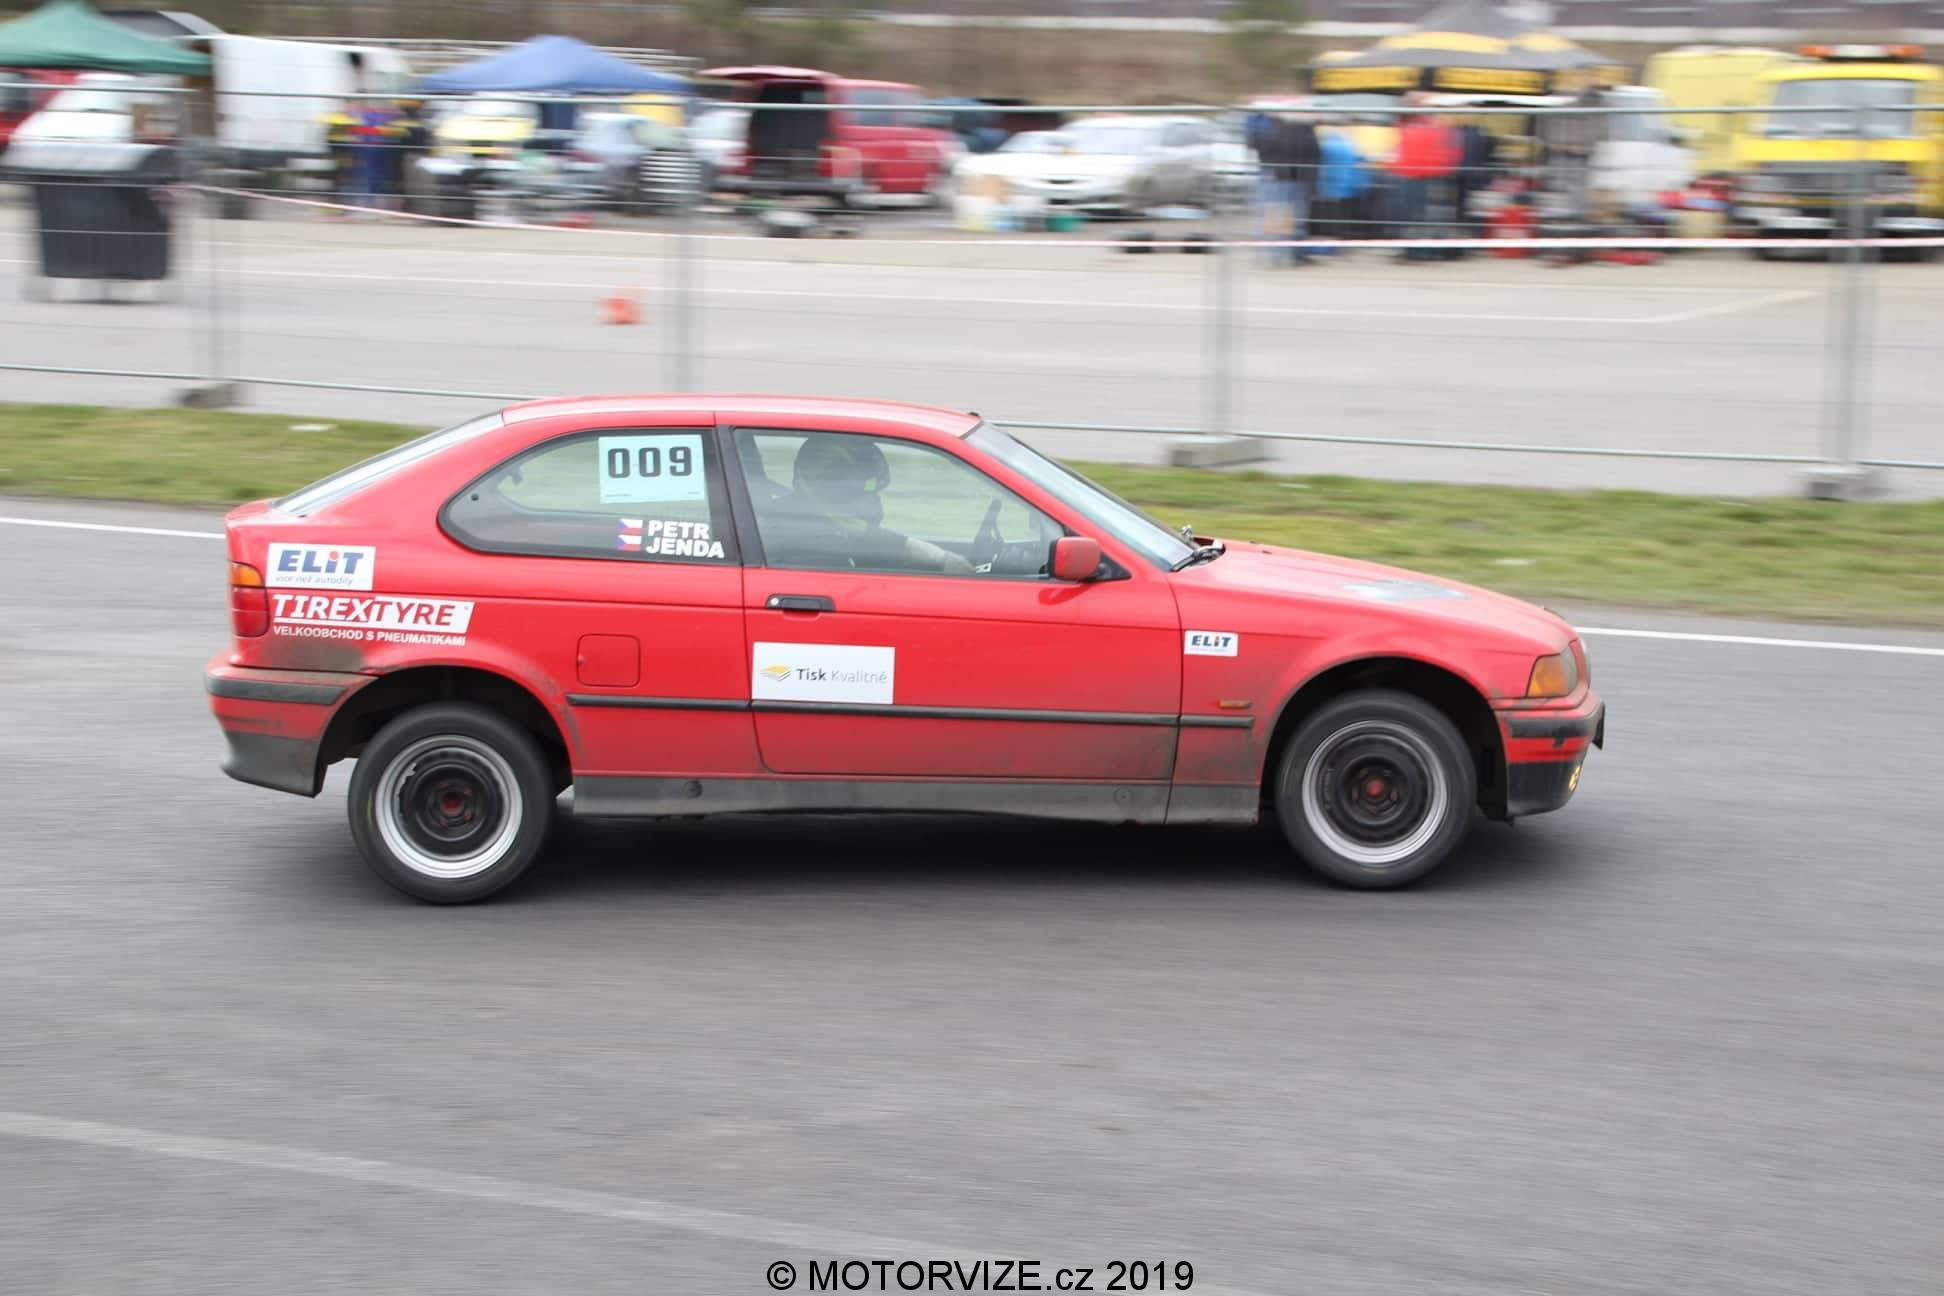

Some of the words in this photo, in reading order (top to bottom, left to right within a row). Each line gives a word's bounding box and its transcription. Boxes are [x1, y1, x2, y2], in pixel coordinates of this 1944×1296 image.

[608, 446, 692, 478] 009
[648, 520, 710, 539] PETR
[646, 537, 725, 558] JENDA
[272, 594, 456, 626] TIREXTYRE
[273, 625, 364, 640] VELKOOBCHOD
[366, 631, 375, 641] S
[376, 631, 467, 646] PNEUMATIKAMI
[796, 668, 827, 681] Tisk
